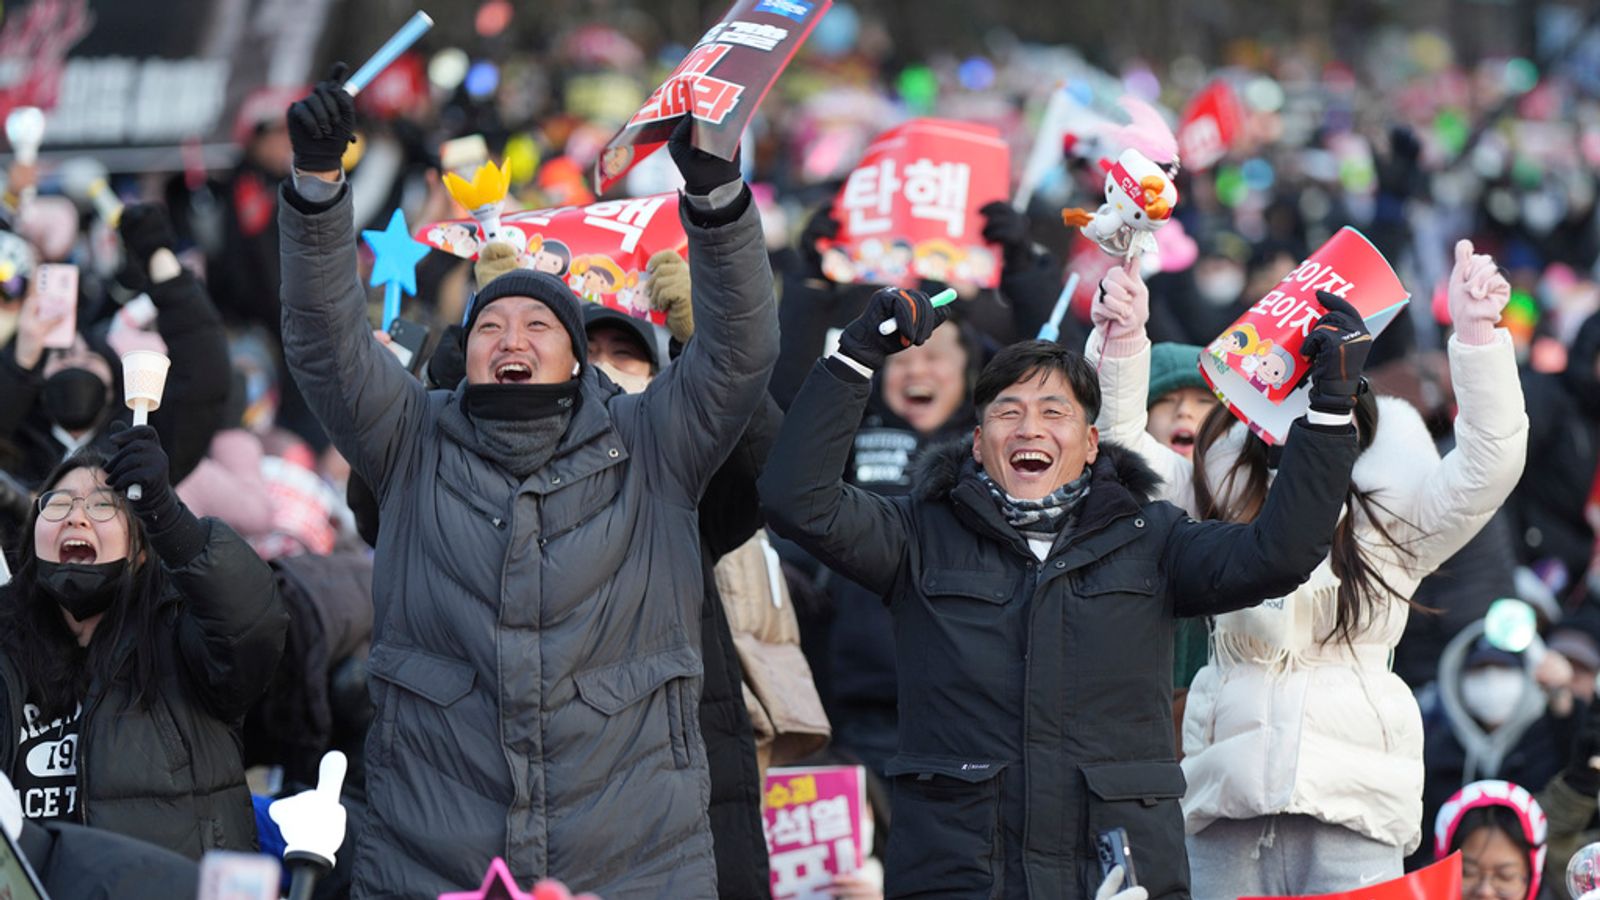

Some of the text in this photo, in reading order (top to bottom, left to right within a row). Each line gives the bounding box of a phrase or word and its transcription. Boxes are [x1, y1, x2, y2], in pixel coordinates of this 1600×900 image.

[843, 157, 971, 238] 탄핵
[46, 739, 74, 770] 19
[763, 794, 853, 852] 석열
